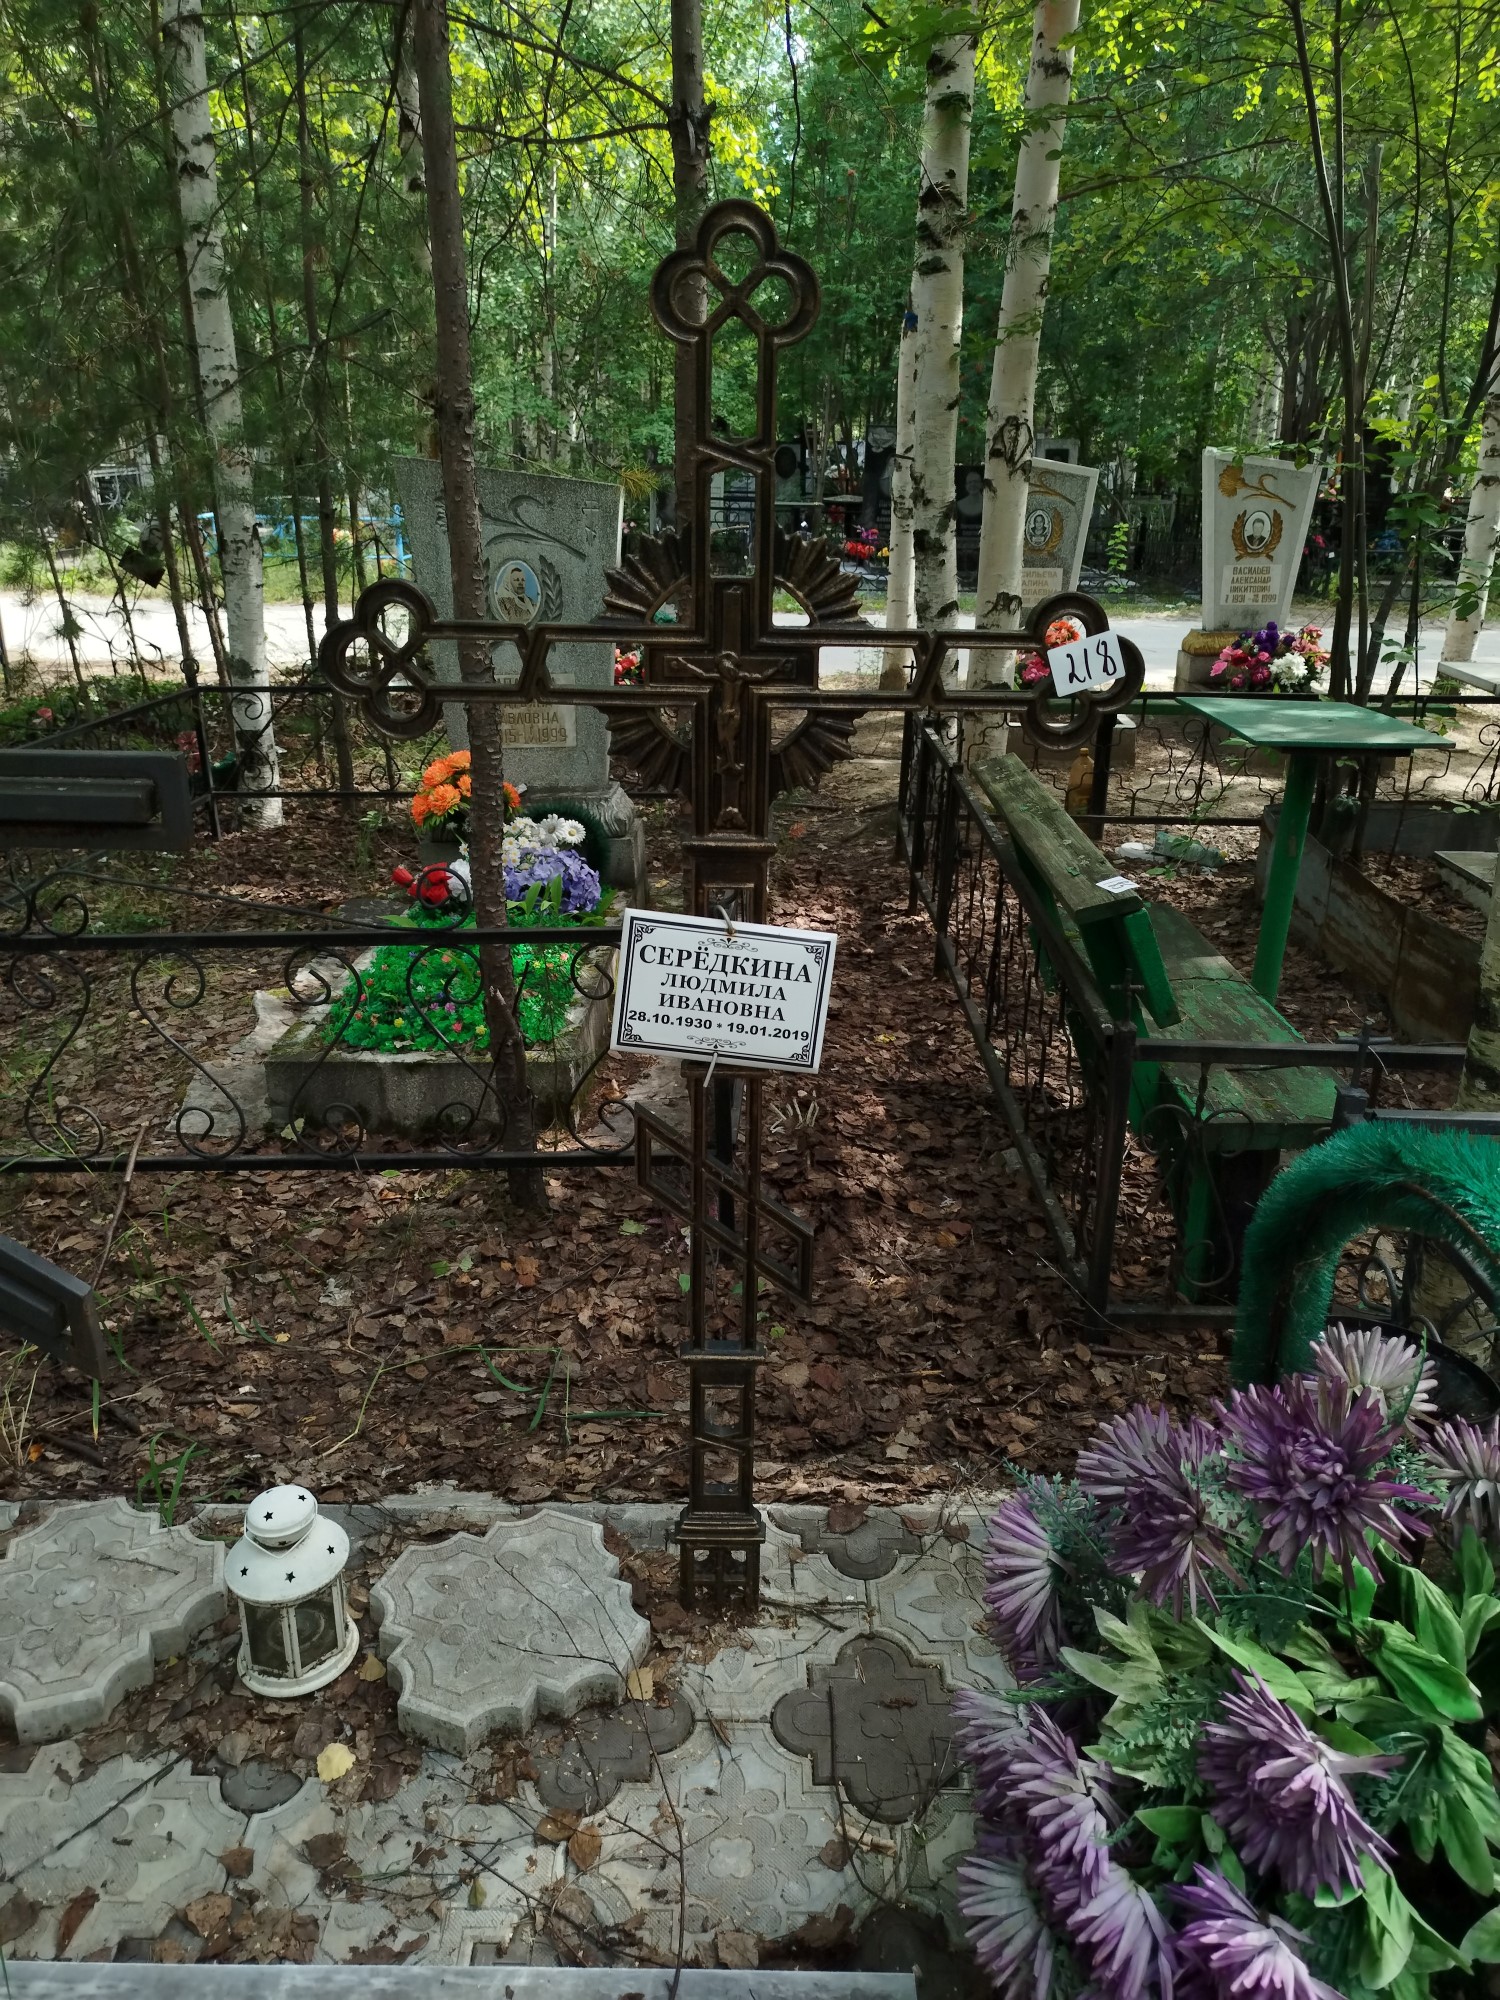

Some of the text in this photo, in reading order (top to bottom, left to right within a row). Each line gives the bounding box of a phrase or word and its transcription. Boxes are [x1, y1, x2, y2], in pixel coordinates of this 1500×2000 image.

[1021, 580, 1050, 588] АЛИНА
[1066, 639, 1117, 684] 218
[501, 712, 559, 725] АВЛОВНА
[639, 944, 813, 983] СЕРЁДКИНА
[660, 972, 787, 1001] ЛЮДМИЛА
[658, 993, 785, 1022] ИВАНОВНА
[628, 1010, 809, 1041] 28.10.1930 19.01.2019
